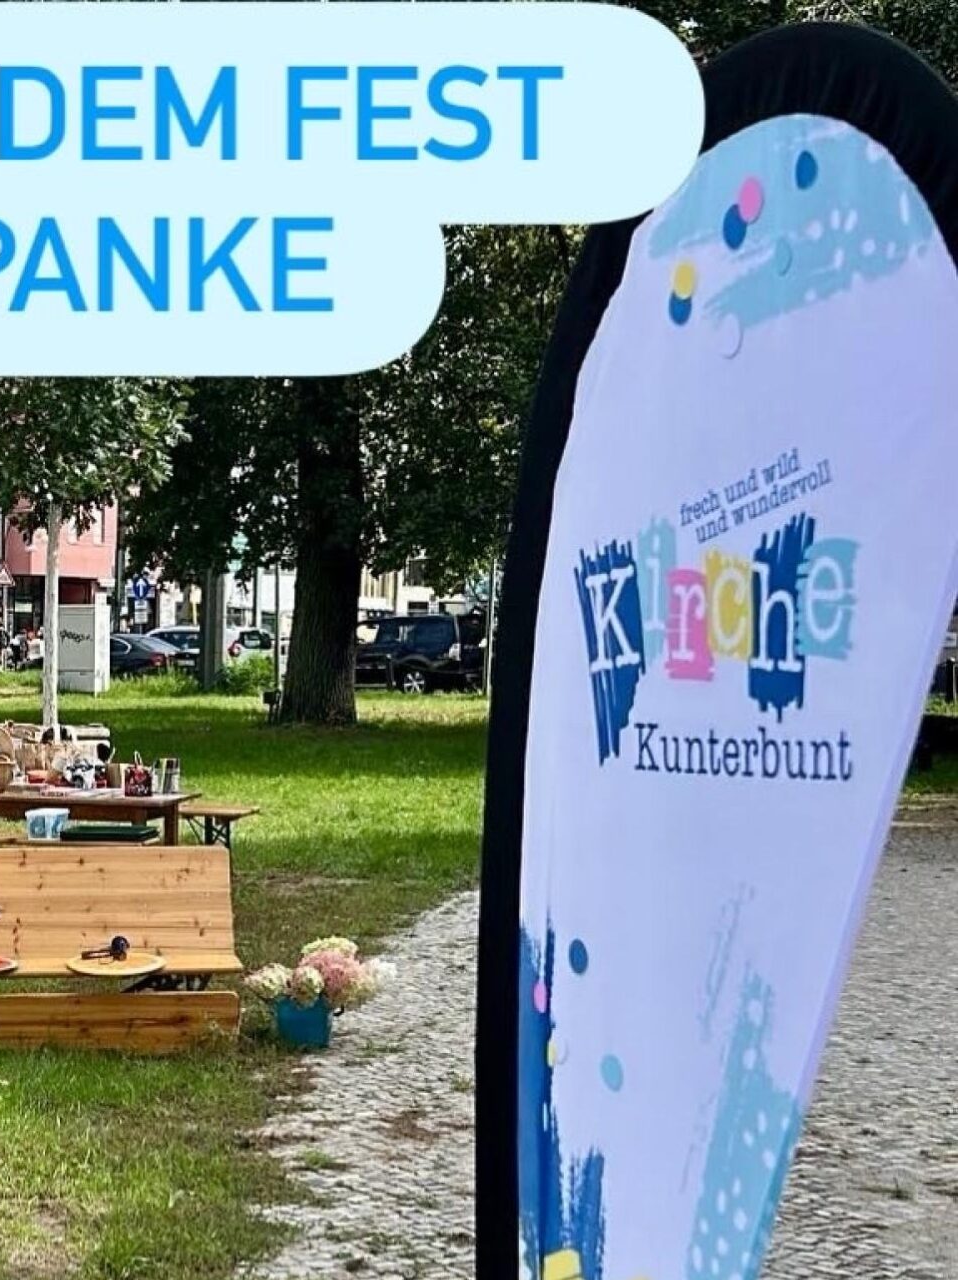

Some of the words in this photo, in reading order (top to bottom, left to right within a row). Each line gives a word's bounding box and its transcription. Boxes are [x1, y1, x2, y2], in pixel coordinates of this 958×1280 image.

[679, 488, 721, 527] frech
[724, 470, 759, 503] und
[761, 447, 800, 484] wild
[695, 509, 729, 544] und
[731, 458, 833, 526] wundervoll
[584, 528, 857, 675] Kirche
[634, 722, 854, 782] Kunterbunt
